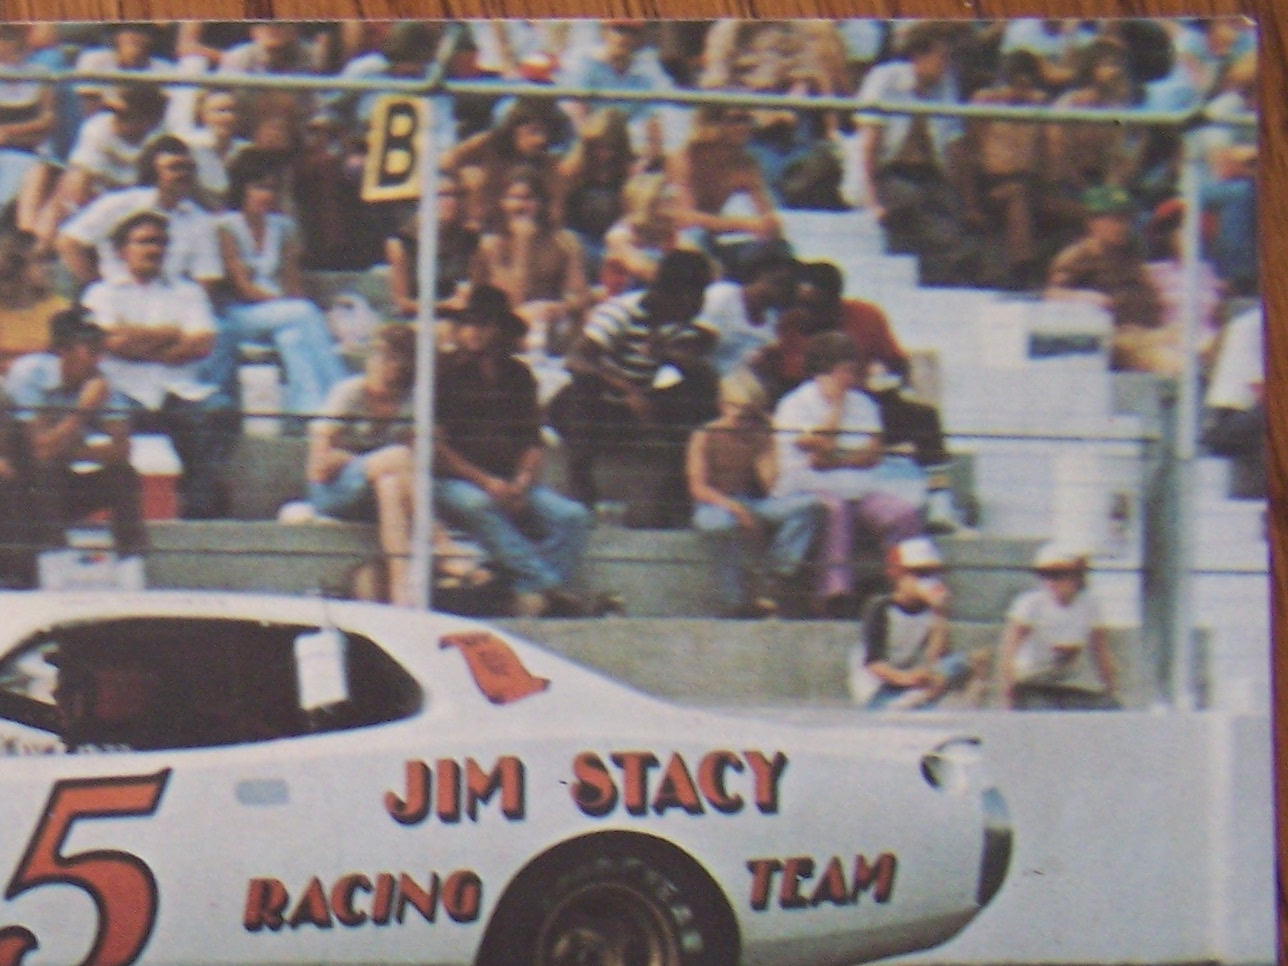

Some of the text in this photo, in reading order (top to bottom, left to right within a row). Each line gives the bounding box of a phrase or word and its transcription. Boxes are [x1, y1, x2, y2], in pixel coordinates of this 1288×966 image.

[379, 103, 416, 187] B
[384, 750, 788, 825] JIM STACY
[243, 869, 483, 932] RACING
[746, 853, 898, 911] TEAM
